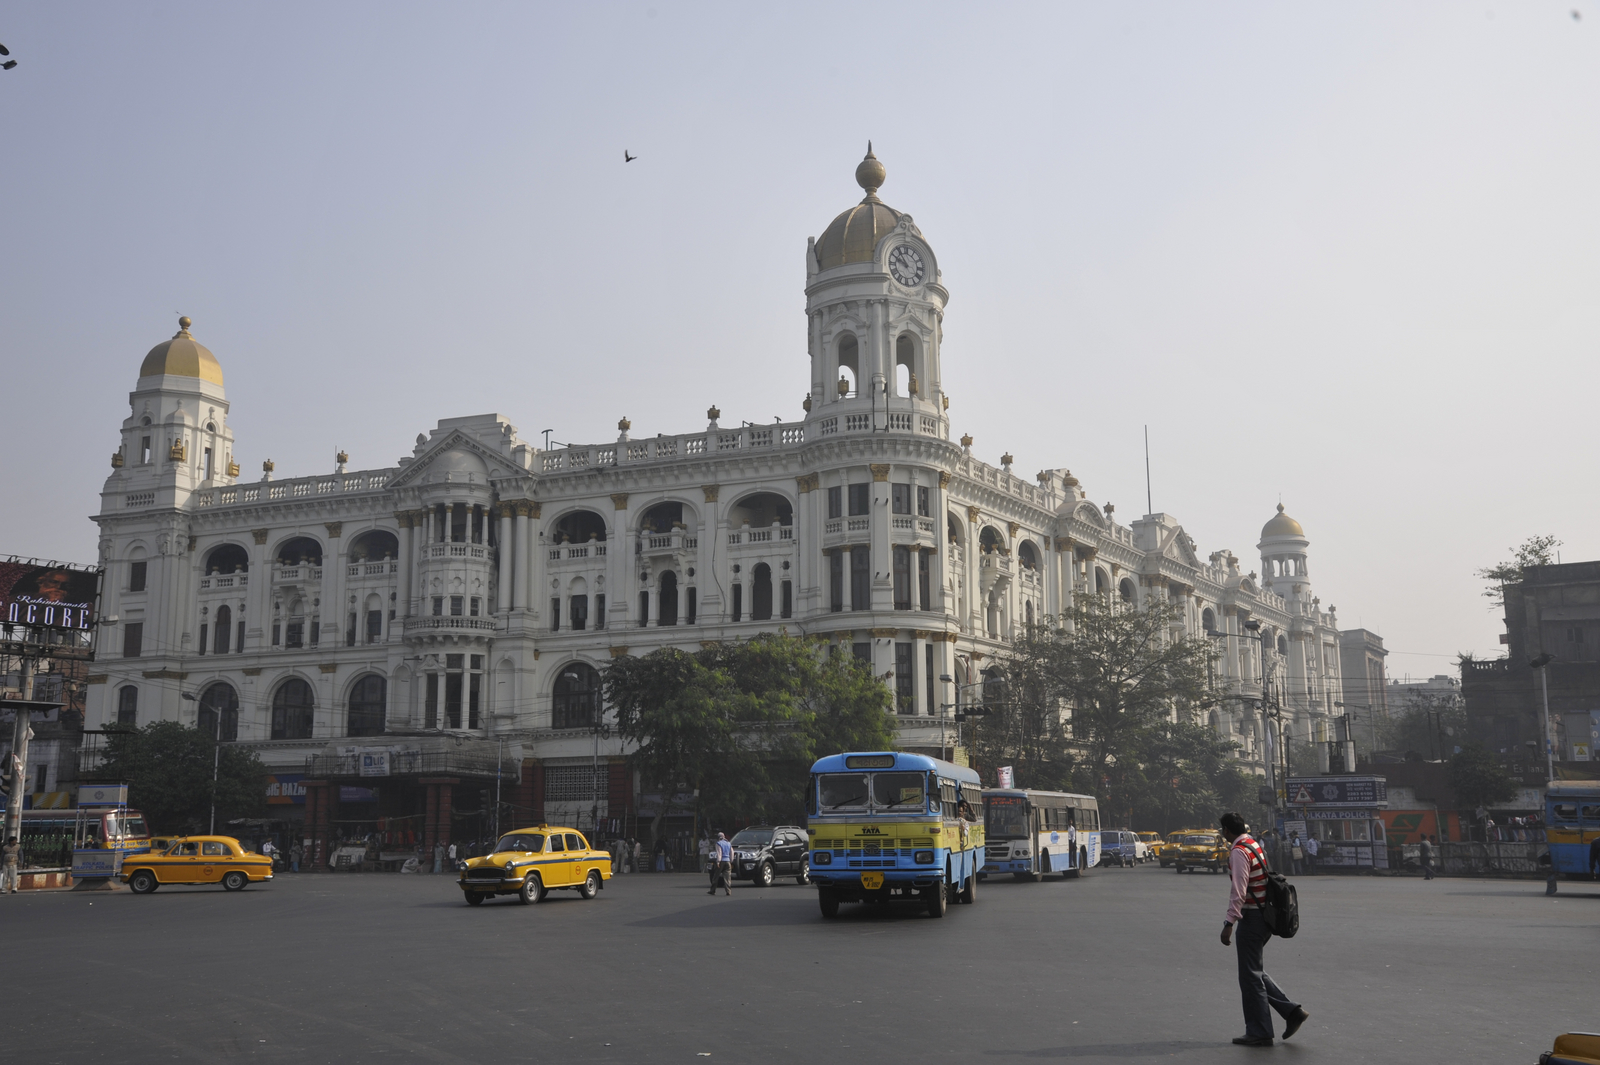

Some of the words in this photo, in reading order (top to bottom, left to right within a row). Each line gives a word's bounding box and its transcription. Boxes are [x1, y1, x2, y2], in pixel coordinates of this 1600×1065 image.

[16, 595, 89, 609] Rabindranath
[0, 602, 90, 630] AGORE
[373, 756, 385, 766] LIC
[1298, 811, 1337, 819] KOLKATA
[1339, 811, 1370, 819] POLICE
